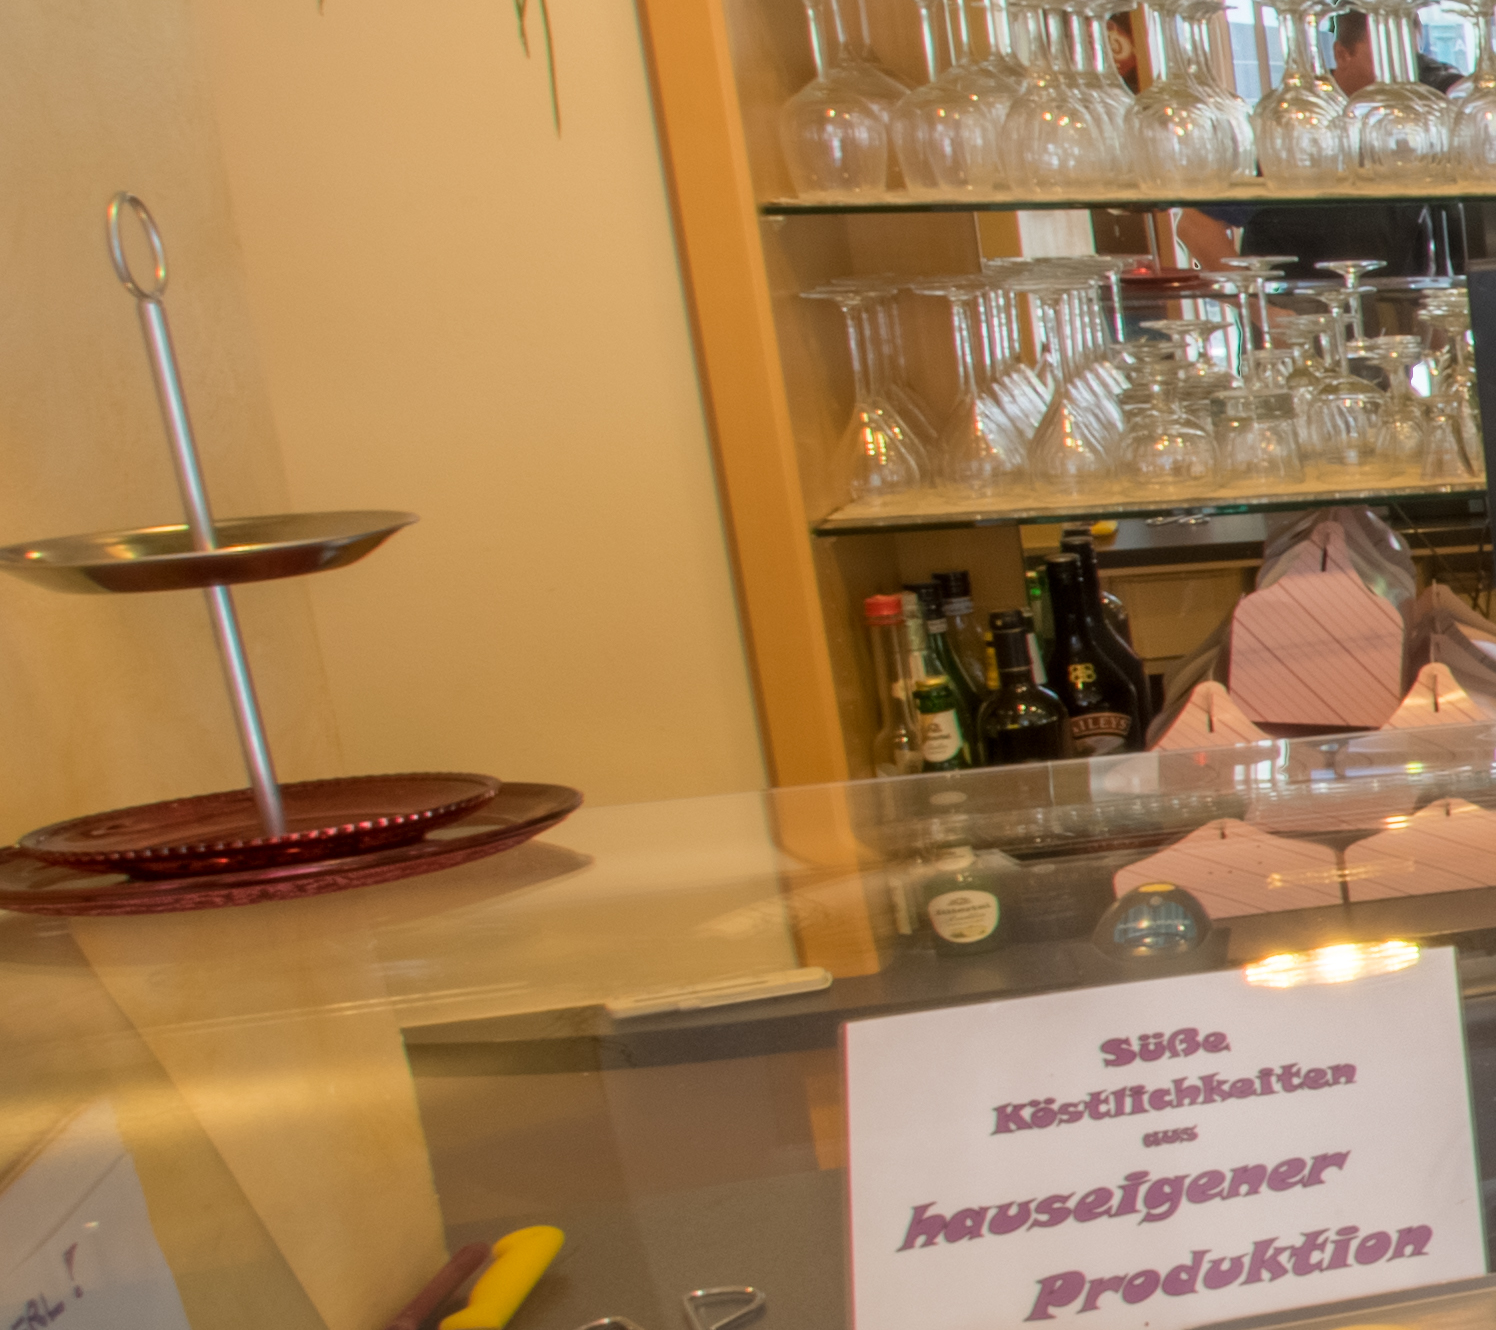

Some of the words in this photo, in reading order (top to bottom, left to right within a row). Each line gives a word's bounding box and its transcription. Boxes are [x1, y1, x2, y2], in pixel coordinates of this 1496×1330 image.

[1100, 1027, 1231, 1068] Süße
[990, 1062, 1357, 1136] Köstlichkeiten
[1142, 1124, 1199, 1148] aus
[896, 1150, 1352, 1252] hauseigener
[1023, 1224, 1433, 1322] Produktion
